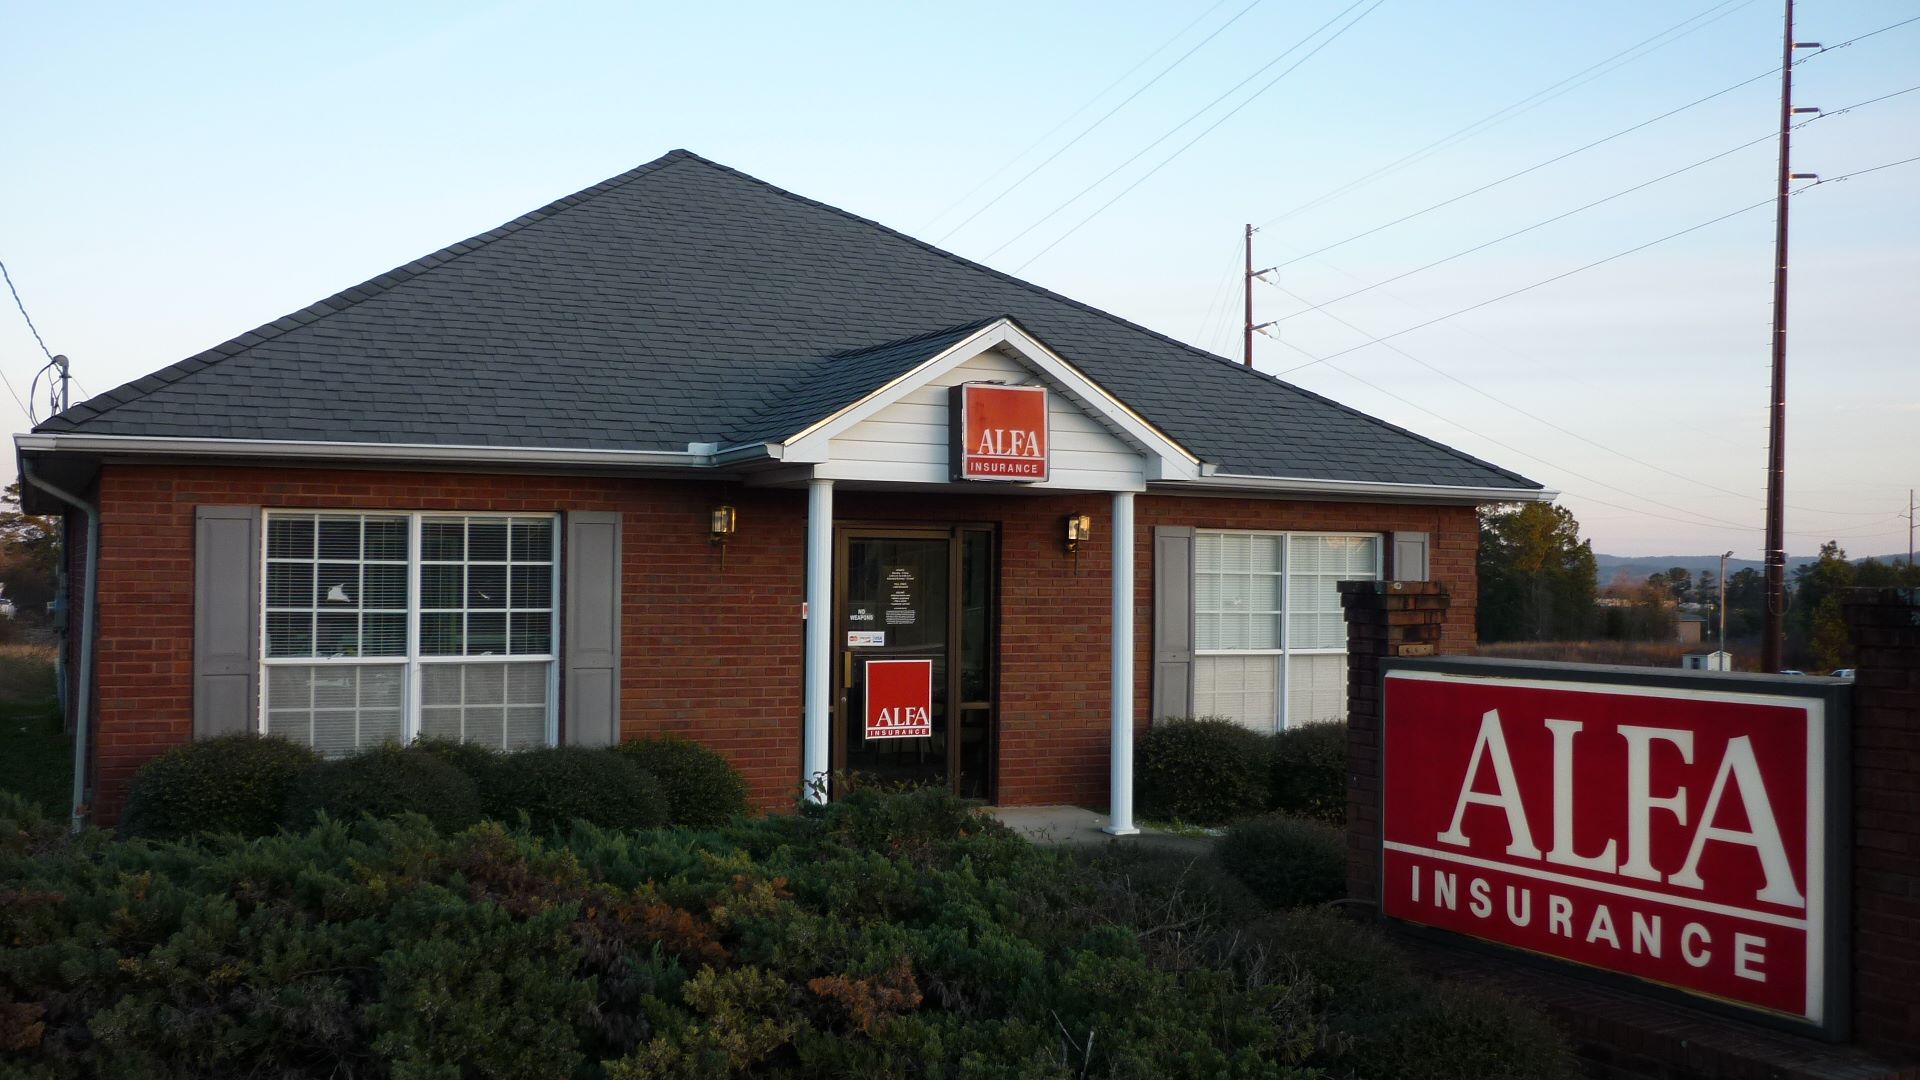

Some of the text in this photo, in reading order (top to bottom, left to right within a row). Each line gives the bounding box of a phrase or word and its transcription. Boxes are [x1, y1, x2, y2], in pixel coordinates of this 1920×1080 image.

[977, 429, 1040, 457] ALFA
[970, 462, 1038, 474] INSURANCE
[875, 707, 930, 727] ALFA
[1437, 708, 1806, 909] ALFA
[1411, 865, 1767, 983] INSURANCE
